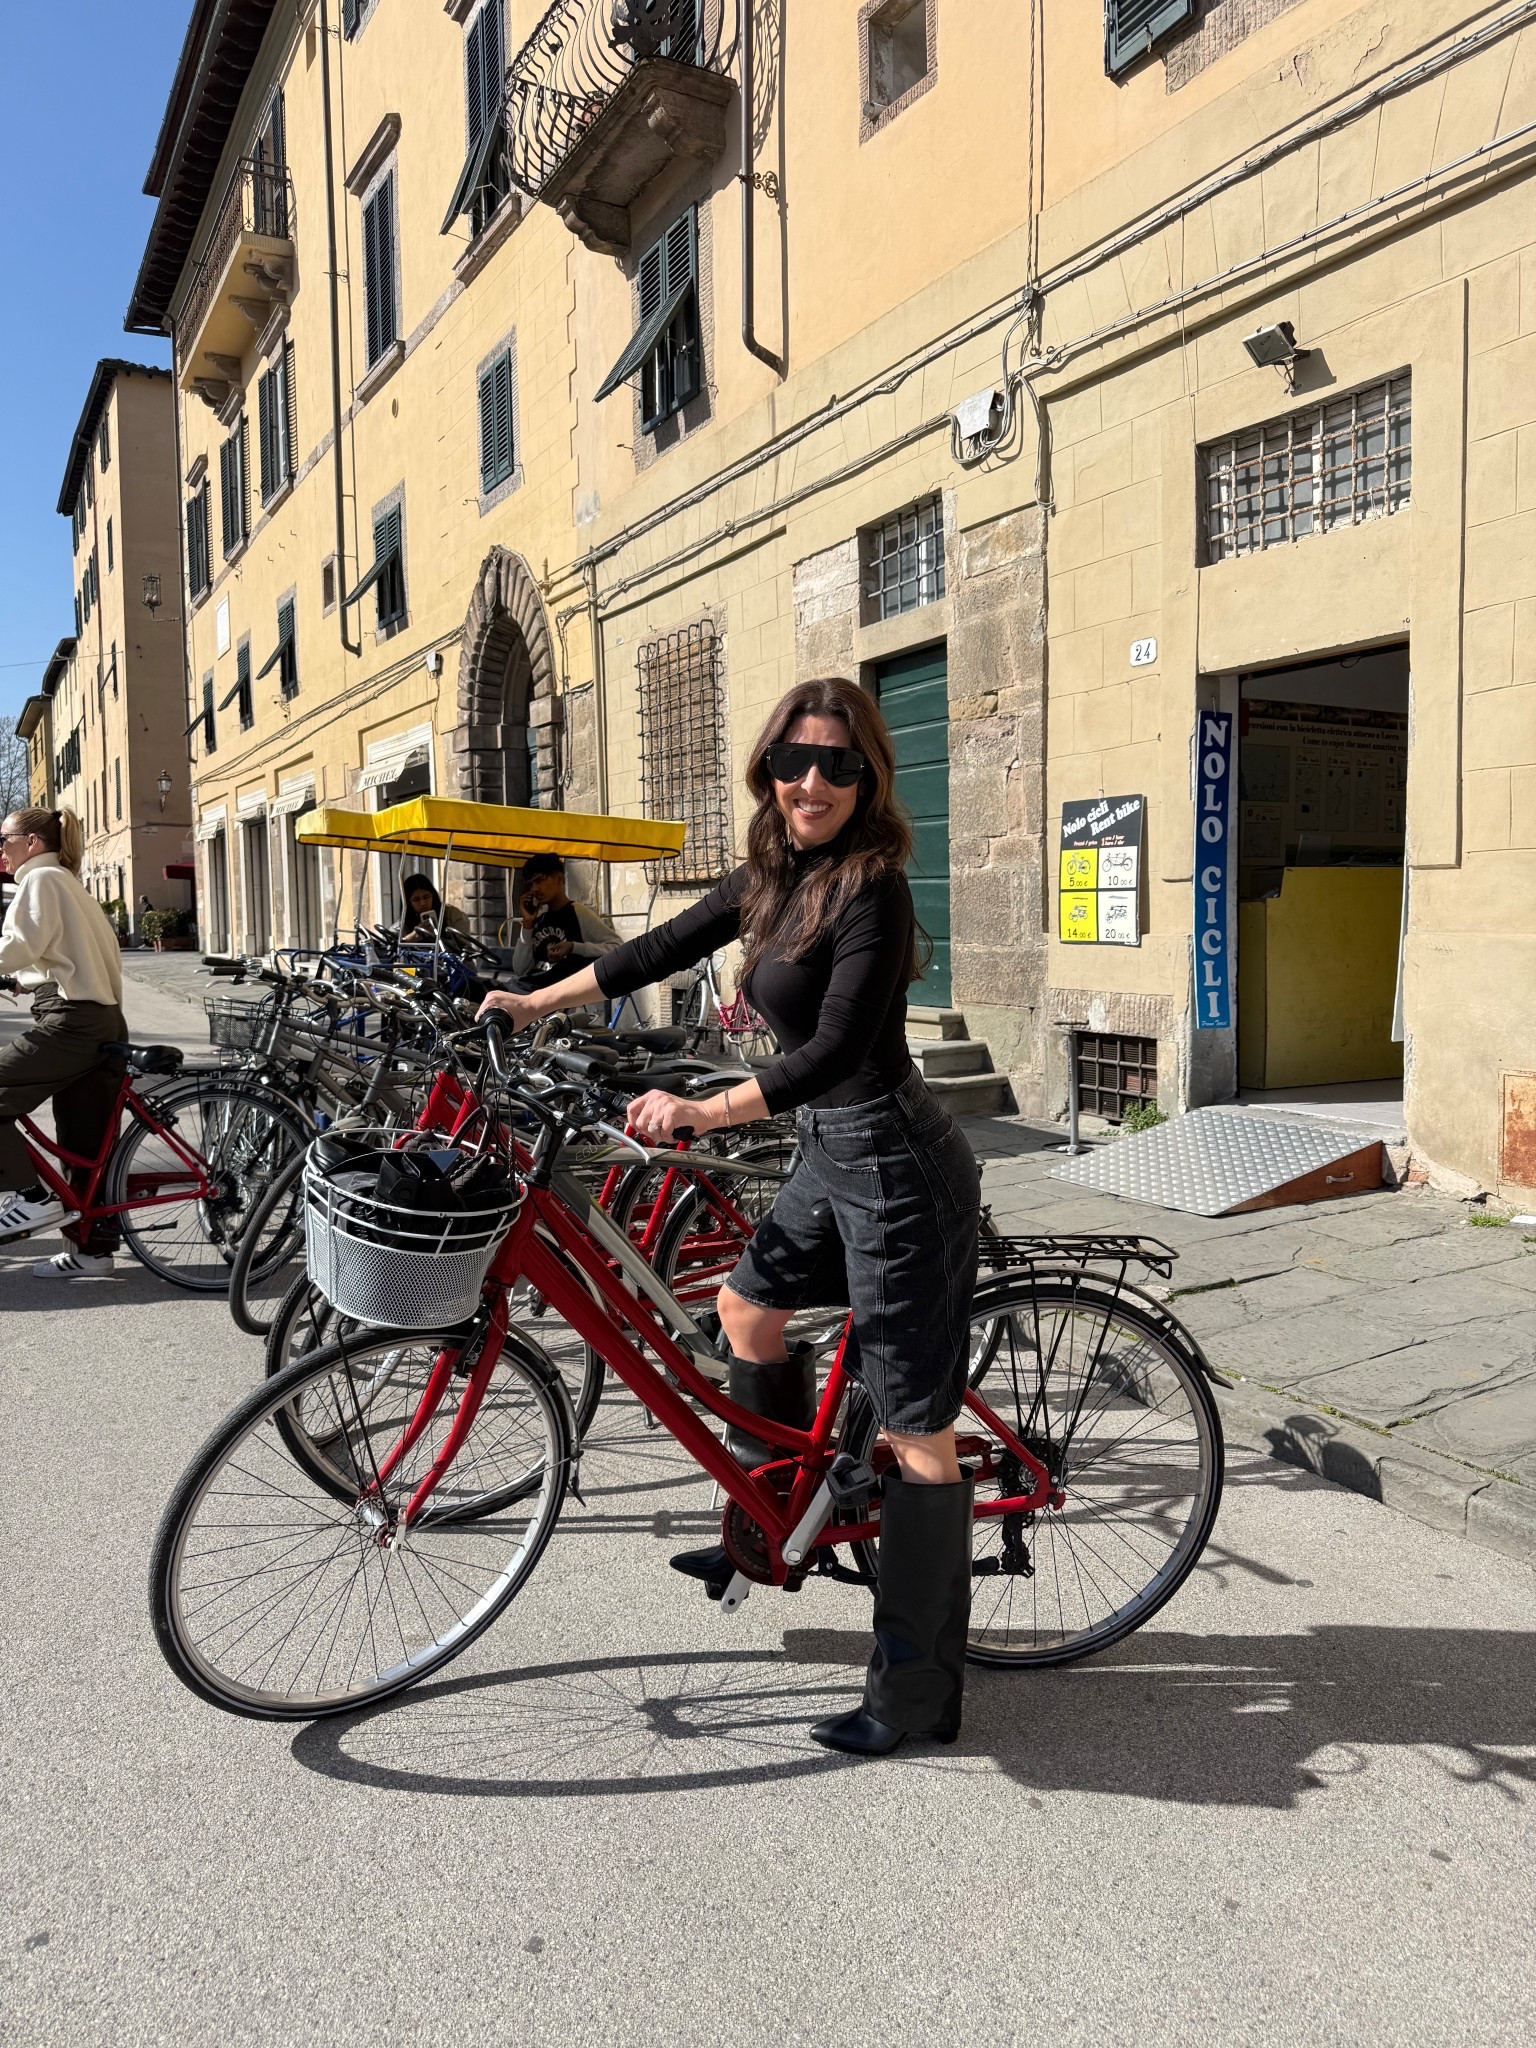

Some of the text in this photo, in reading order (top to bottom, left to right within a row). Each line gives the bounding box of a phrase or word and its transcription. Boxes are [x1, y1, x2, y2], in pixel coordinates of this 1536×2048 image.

[1134, 642, 1151, 662] 24
[1297, 723, 1326, 734] bicicletta
[1302, 736, 1320, 745] Come
[363, 768, 397, 787] MICHEL
[1062, 800, 1110, 838] Nolo cicli
[1090, 799, 1141, 836] Rent bike
[1201, 719, 1228, 1018] NOLO CICLI
